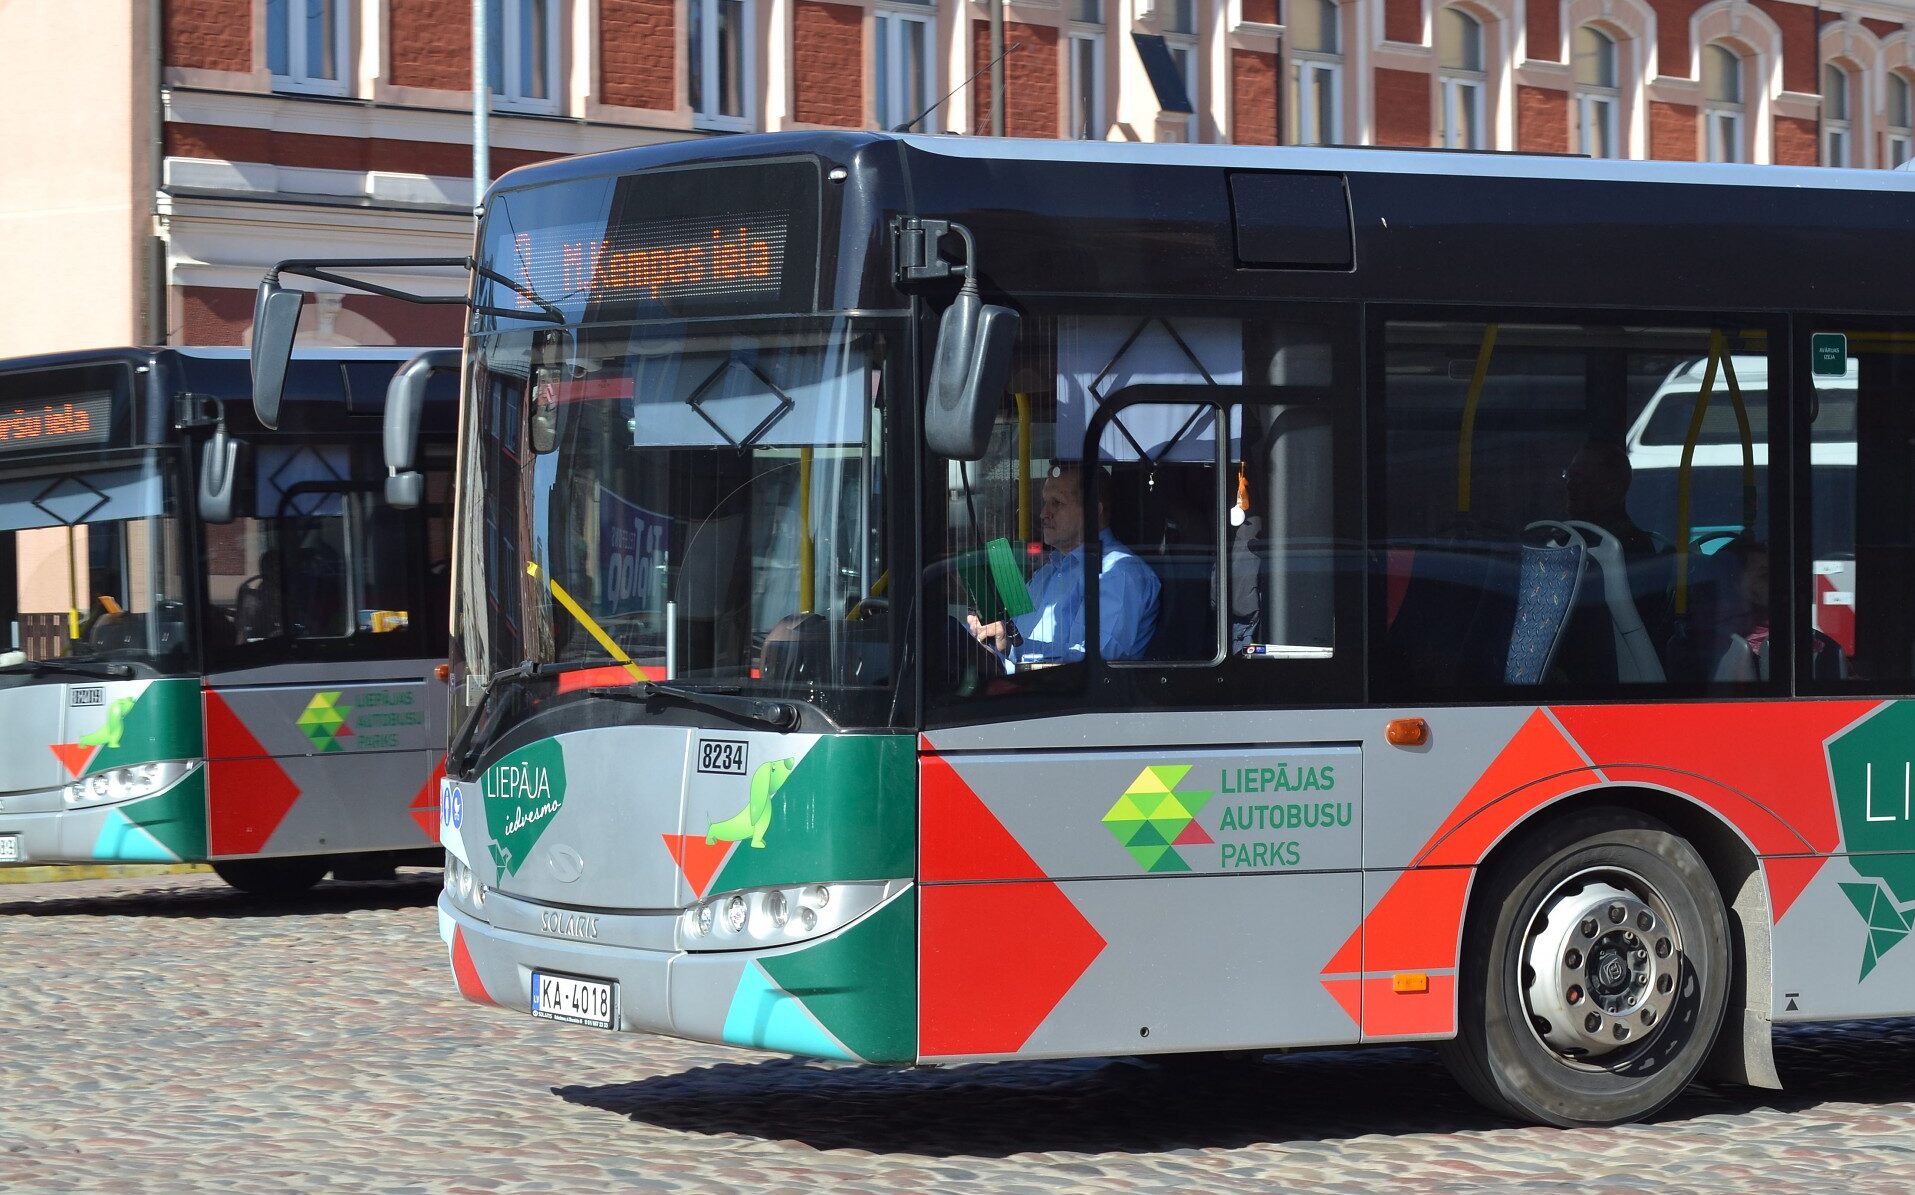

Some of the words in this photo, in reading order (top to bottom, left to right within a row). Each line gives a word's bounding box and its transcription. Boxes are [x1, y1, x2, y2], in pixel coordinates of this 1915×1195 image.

[712, 226, 768, 280] iela
[44, 404, 90, 435] iela
[703, 743, 743, 771] 8234
[487, 762, 551, 799] LIEPĀJA
[1221, 762, 1335, 794] LIEPĀJAS
[1219, 802, 1353, 831] AUTOBUSU
[1221, 841, 1301, 868] PARKS
[541, 910, 600, 940] SOLARIS
